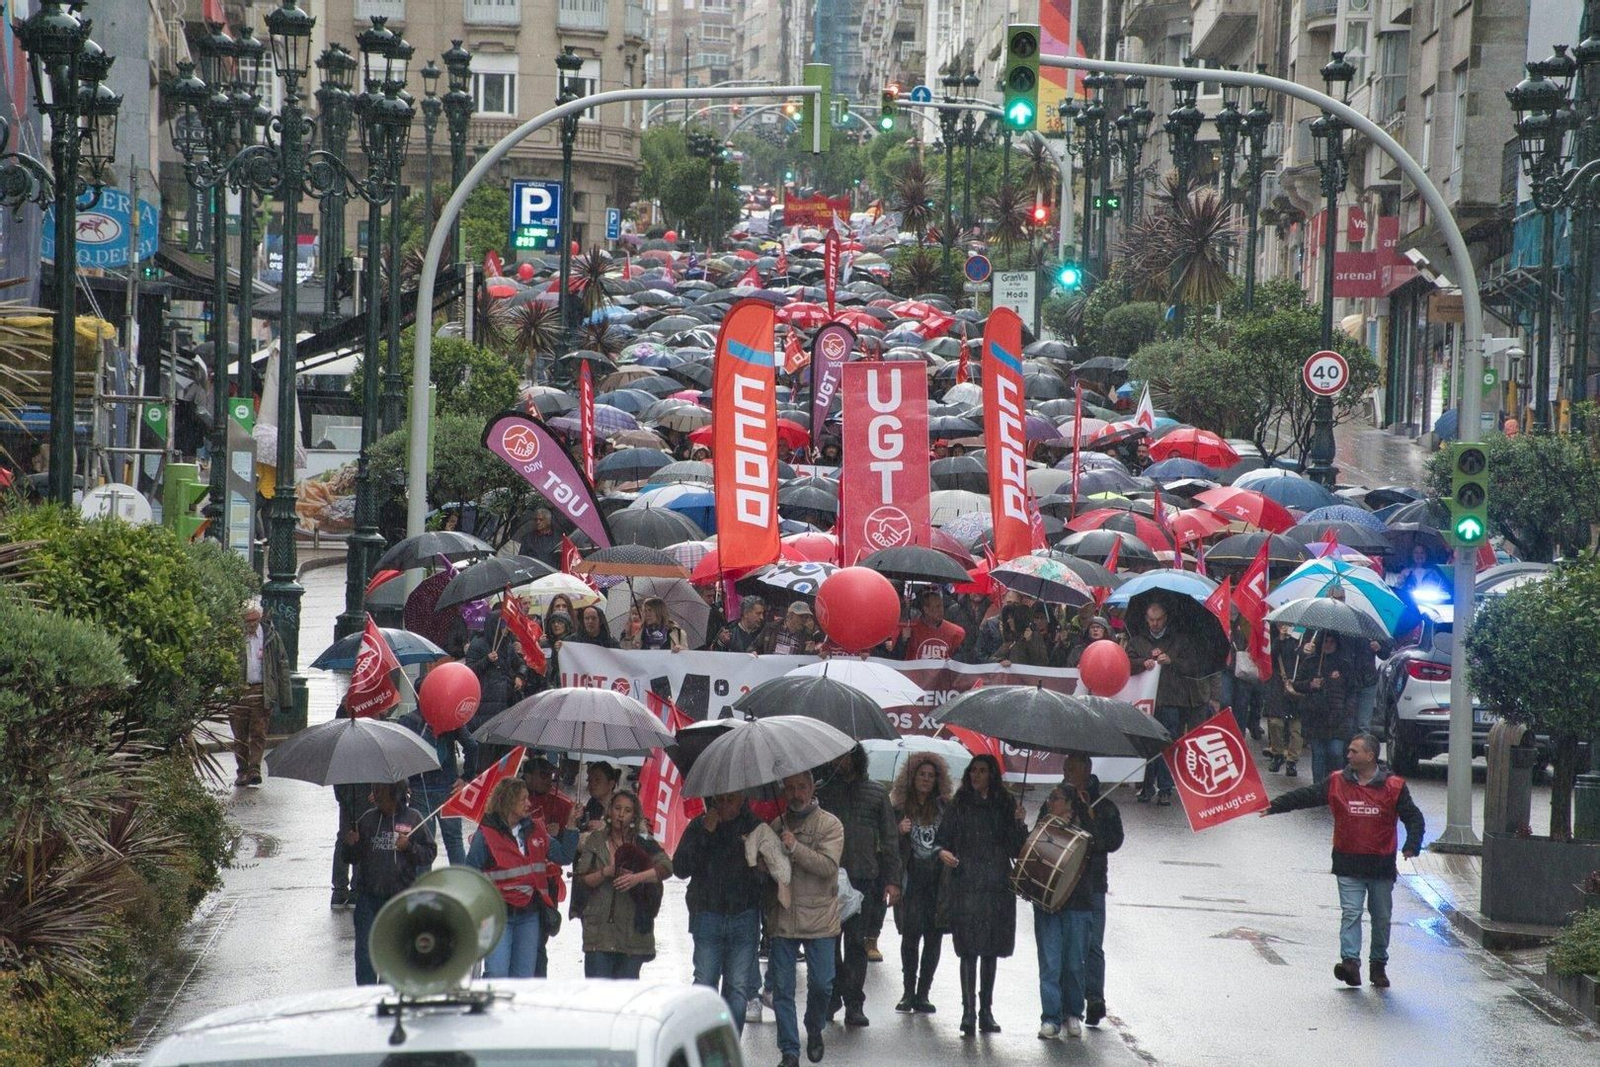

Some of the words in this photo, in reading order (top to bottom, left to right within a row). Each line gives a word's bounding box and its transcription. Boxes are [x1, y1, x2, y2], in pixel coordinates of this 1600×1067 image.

[521, 187, 552, 225] P
[1336, 270, 1376, 280] arenal
[815, 370, 837, 408] UGT
[1312, 365, 1339, 379] 40
[734, 373, 770, 528] CCOO
[866, 368, 904, 504] UGT
[997, 374, 1029, 525] CCOO
[1195, 732, 1239, 784] UGT
[1198, 792, 1257, 819] www.ugt.es
